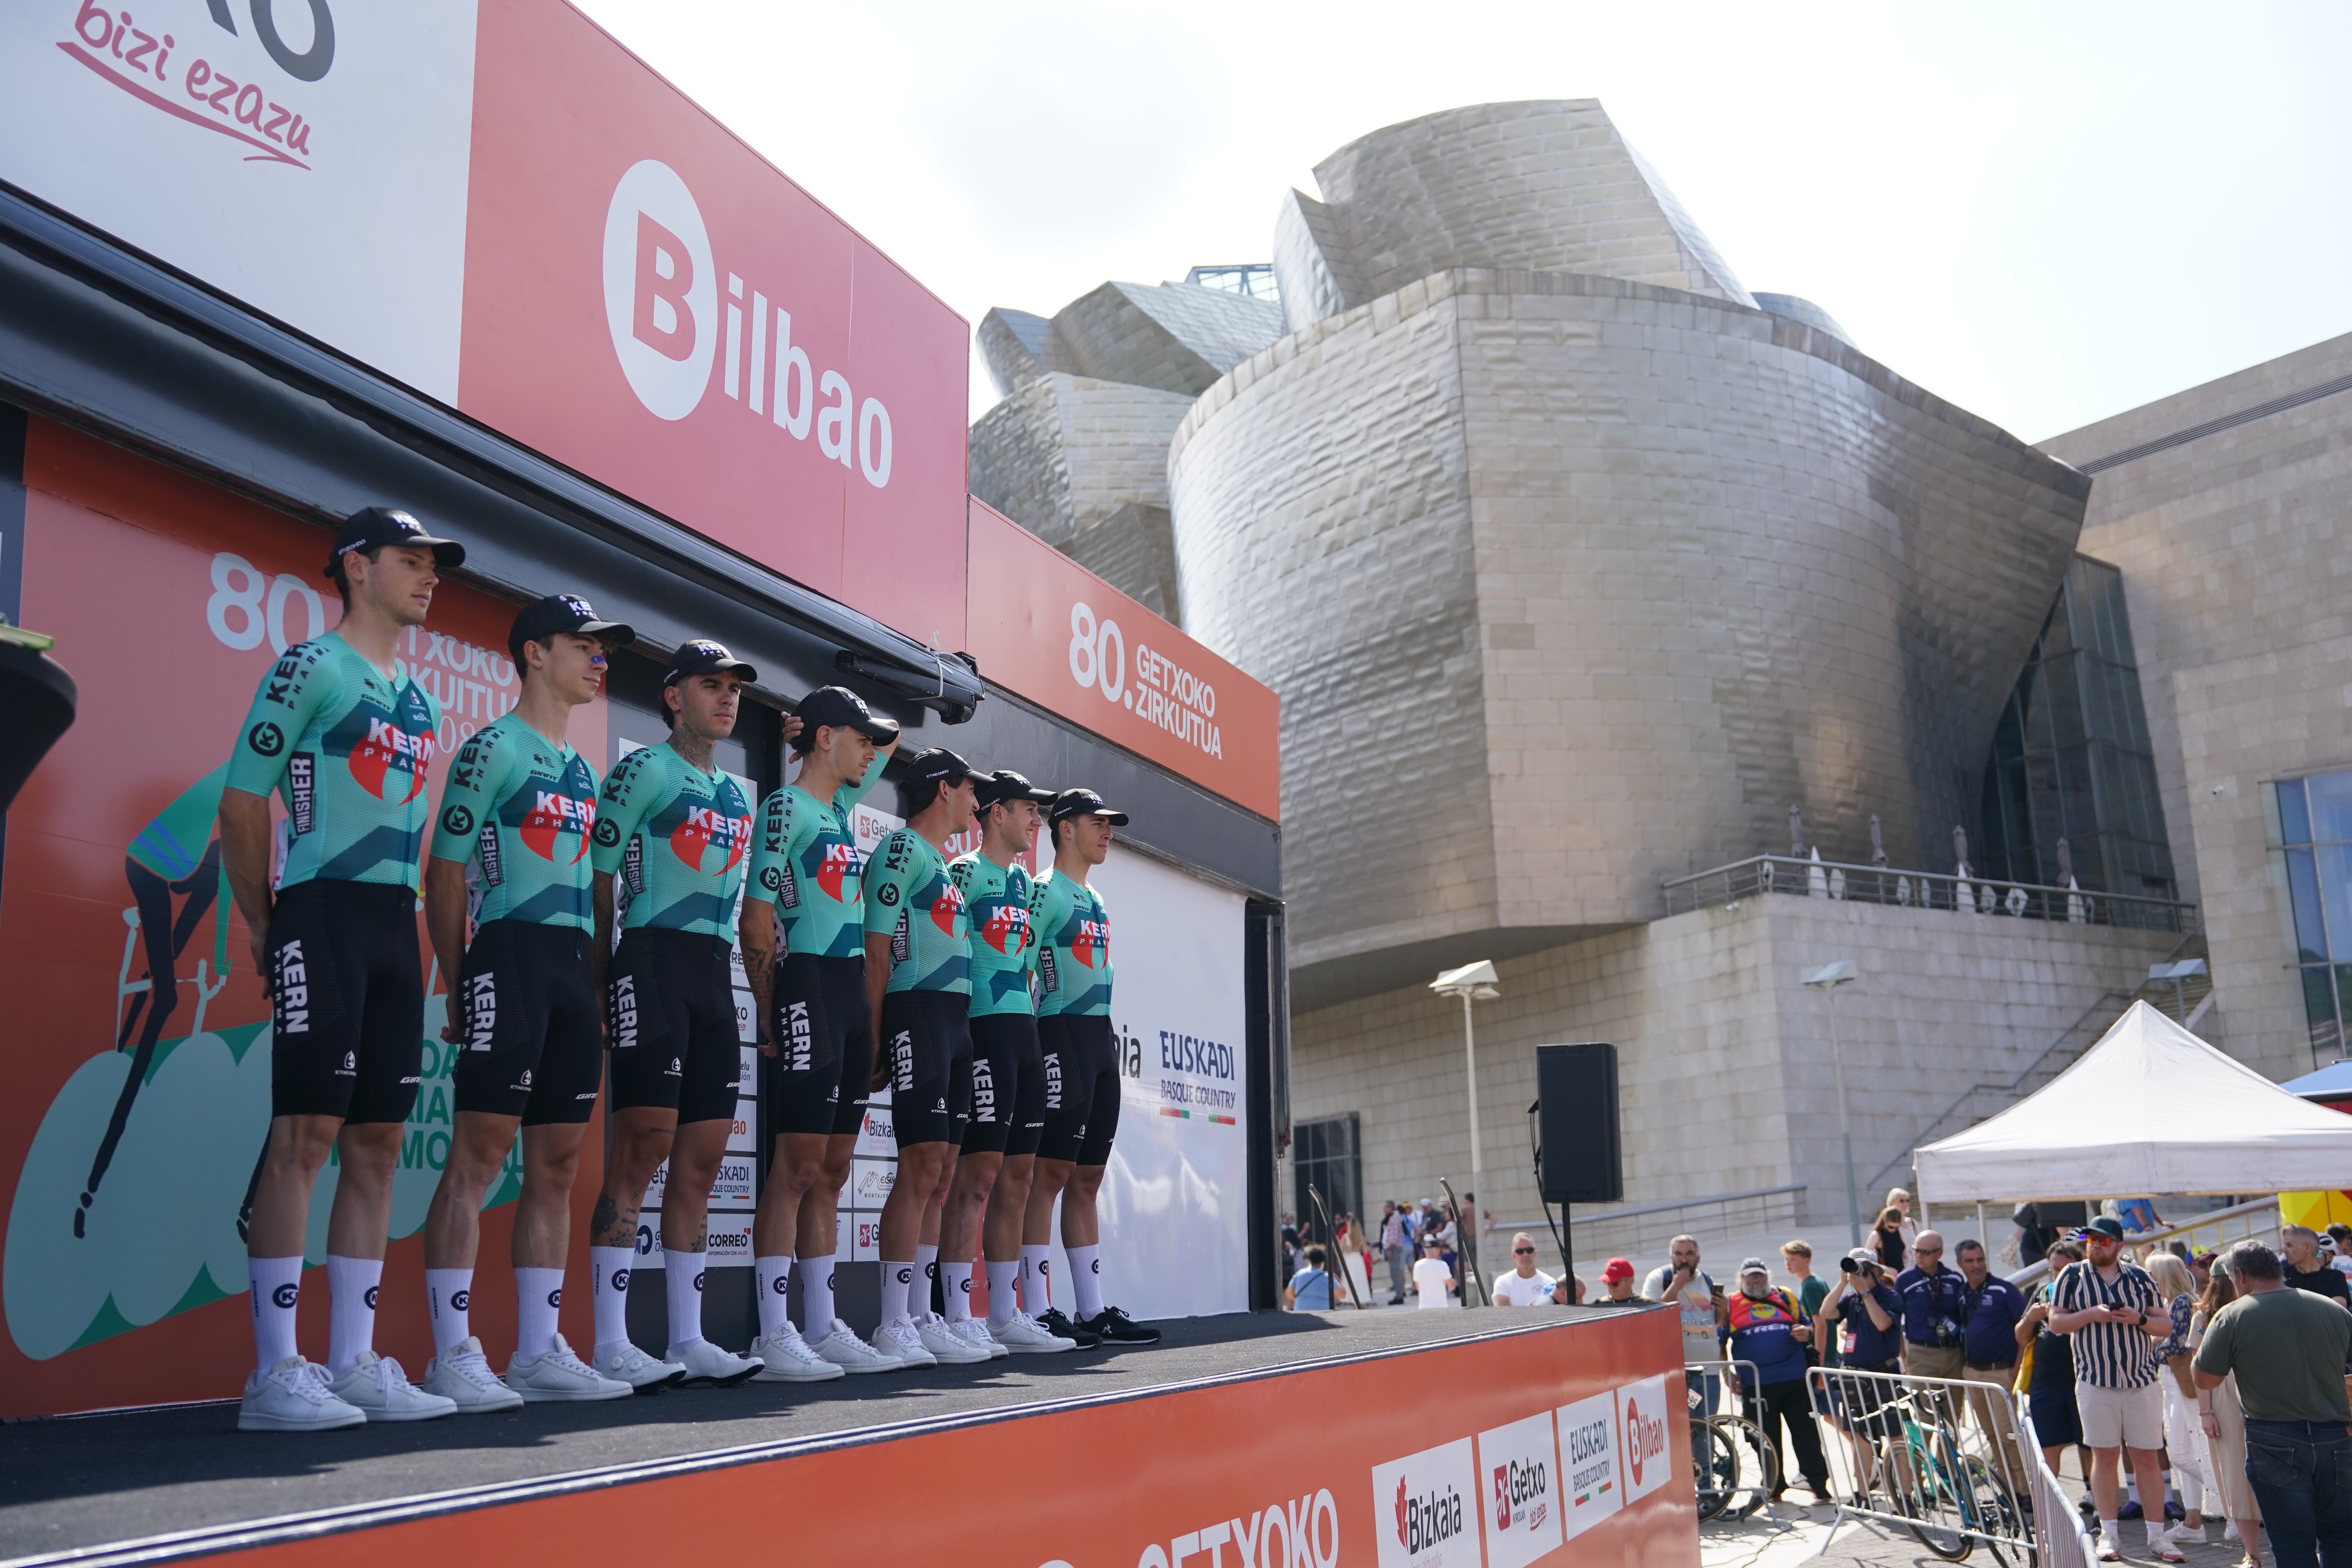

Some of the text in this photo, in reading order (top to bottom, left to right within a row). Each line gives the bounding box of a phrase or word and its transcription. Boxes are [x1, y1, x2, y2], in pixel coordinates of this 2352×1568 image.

[76, 0, 175, 81] bizi
[186, 58, 309, 155] ezazu
[632, 209, 892, 488] Bilbao
[1136, 644, 1215, 718] GETXOKO
[368, 717, 435, 763] KERN
[1135, 681, 1222, 760] ZIRKUITUA
[473, 730, 506, 792] PHARMA
[926, 769, 949, 778] ETXEONDO
[290, 758, 311, 833] FINISHER
[536, 791, 596, 825] KERN
[687, 805, 753, 840] KERN
[981, 798, 1000, 811] ETXEONDO
[1054, 806, 1072, 817] ETXEONDO
[480, 826, 501, 886] FINISHER
[871, 818, 893, 838] Getx
[627, 837, 643, 894] FINISHER
[274, 950, 283, 1035] PHARMA
[283, 940, 309, 1033] KERN
[1040, 949, 1056, 992] FINISHER
[461, 979, 472, 1051] PHARMA
[470, 972, 496, 1051] KERN
[617, 975, 638, 1047] KERN
[780, 1007, 789, 1071] PHARMA
[789, 1001, 811, 1071] KERN
[895, 1030, 913, 1091] KERN
[1043, 1053, 1062, 1109] KERN
[1160, 1030, 1235, 1081] EUSKADI
[973, 1058, 996, 1122] KERN
[1161, 1078, 1236, 1109] BASQUE COUNTRY
[717, 1166, 749, 1181] SKADI
[724, 1185, 750, 1193] COUNTRY
[708, 1234, 748, 1247] CORREO
[1743, 1323, 1790, 1336] TREK
[1570, 1418, 1608, 1465] EUSKADI
[1630, 1413, 1664, 1466] Bilbao
[1510, 1457, 1545, 1507] Getxo
[1573, 1459, 1610, 1492] BASQUE COUNTRY
[1408, 1484, 1462, 1555] Bizkaia
